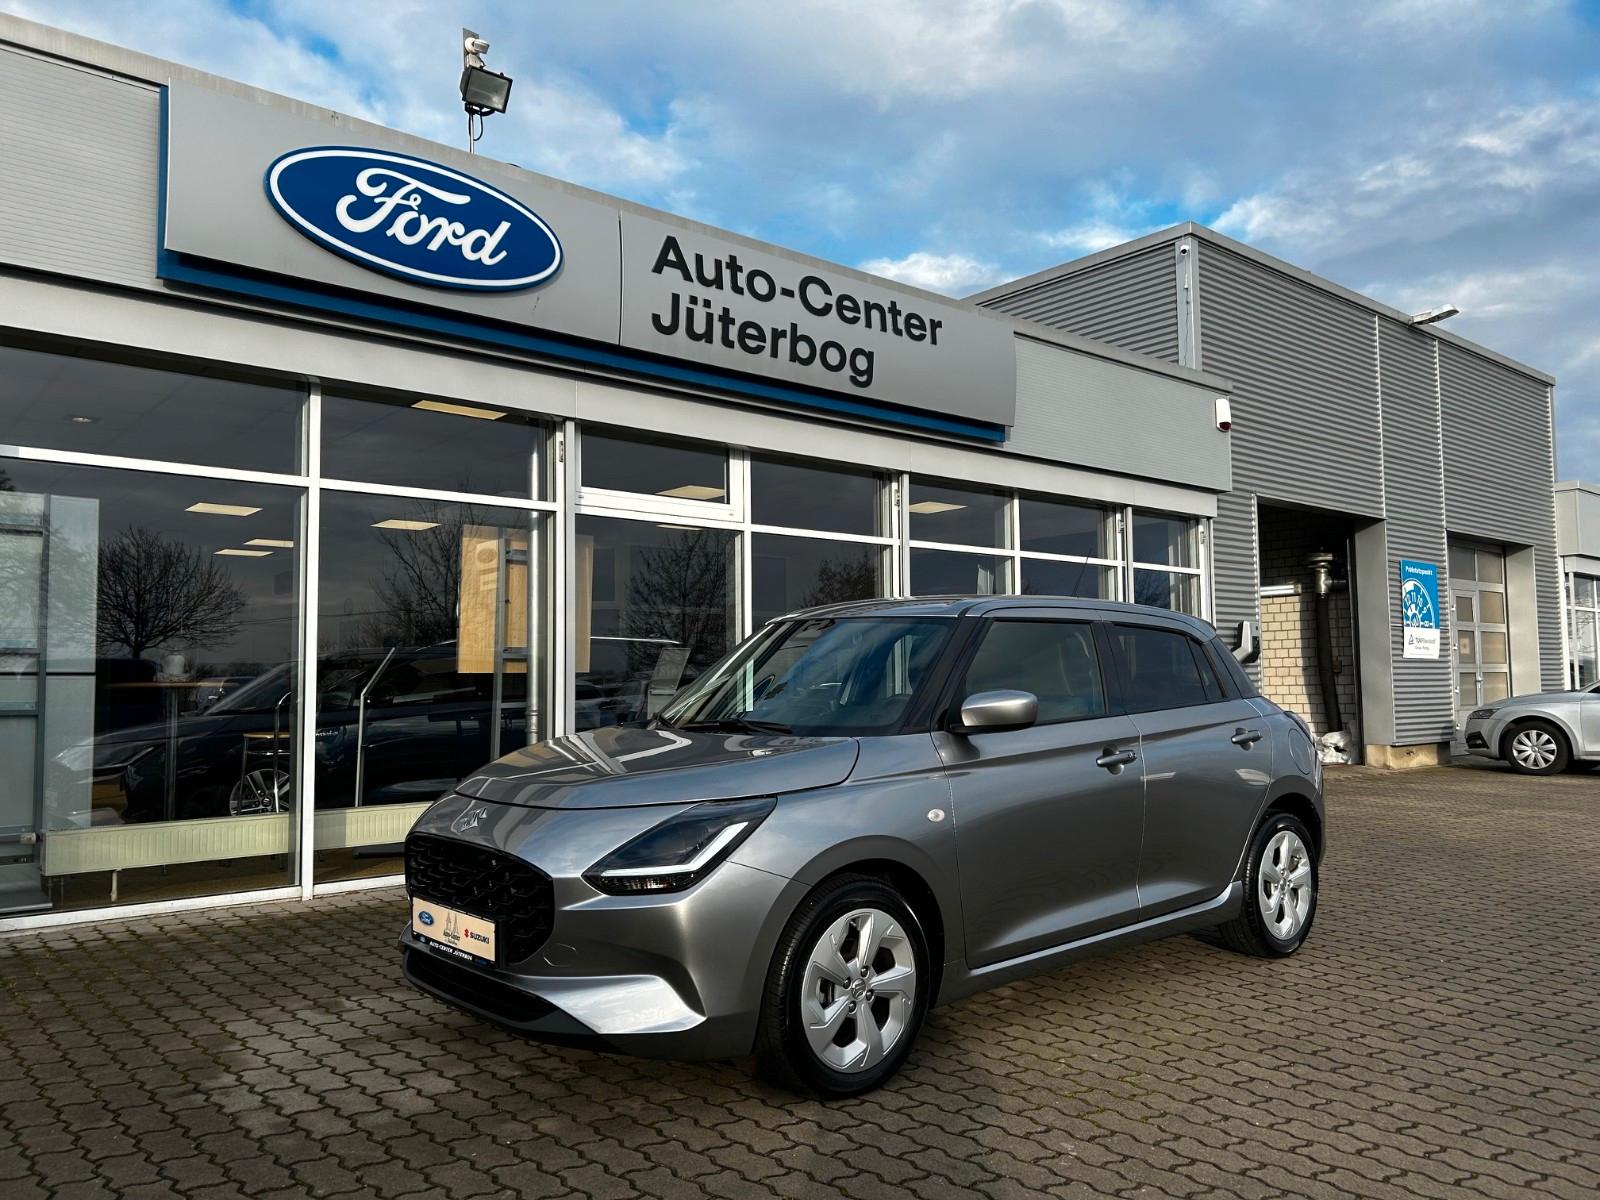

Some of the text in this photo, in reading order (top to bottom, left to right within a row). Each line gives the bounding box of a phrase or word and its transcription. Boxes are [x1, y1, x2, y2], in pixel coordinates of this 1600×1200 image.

[335, 167, 511, 266] Ford
[651, 235, 942, 345] Auto-Center
[651, 292, 874, 388] Jüterbog
[470, 932, 490, 944] SUZUKI
